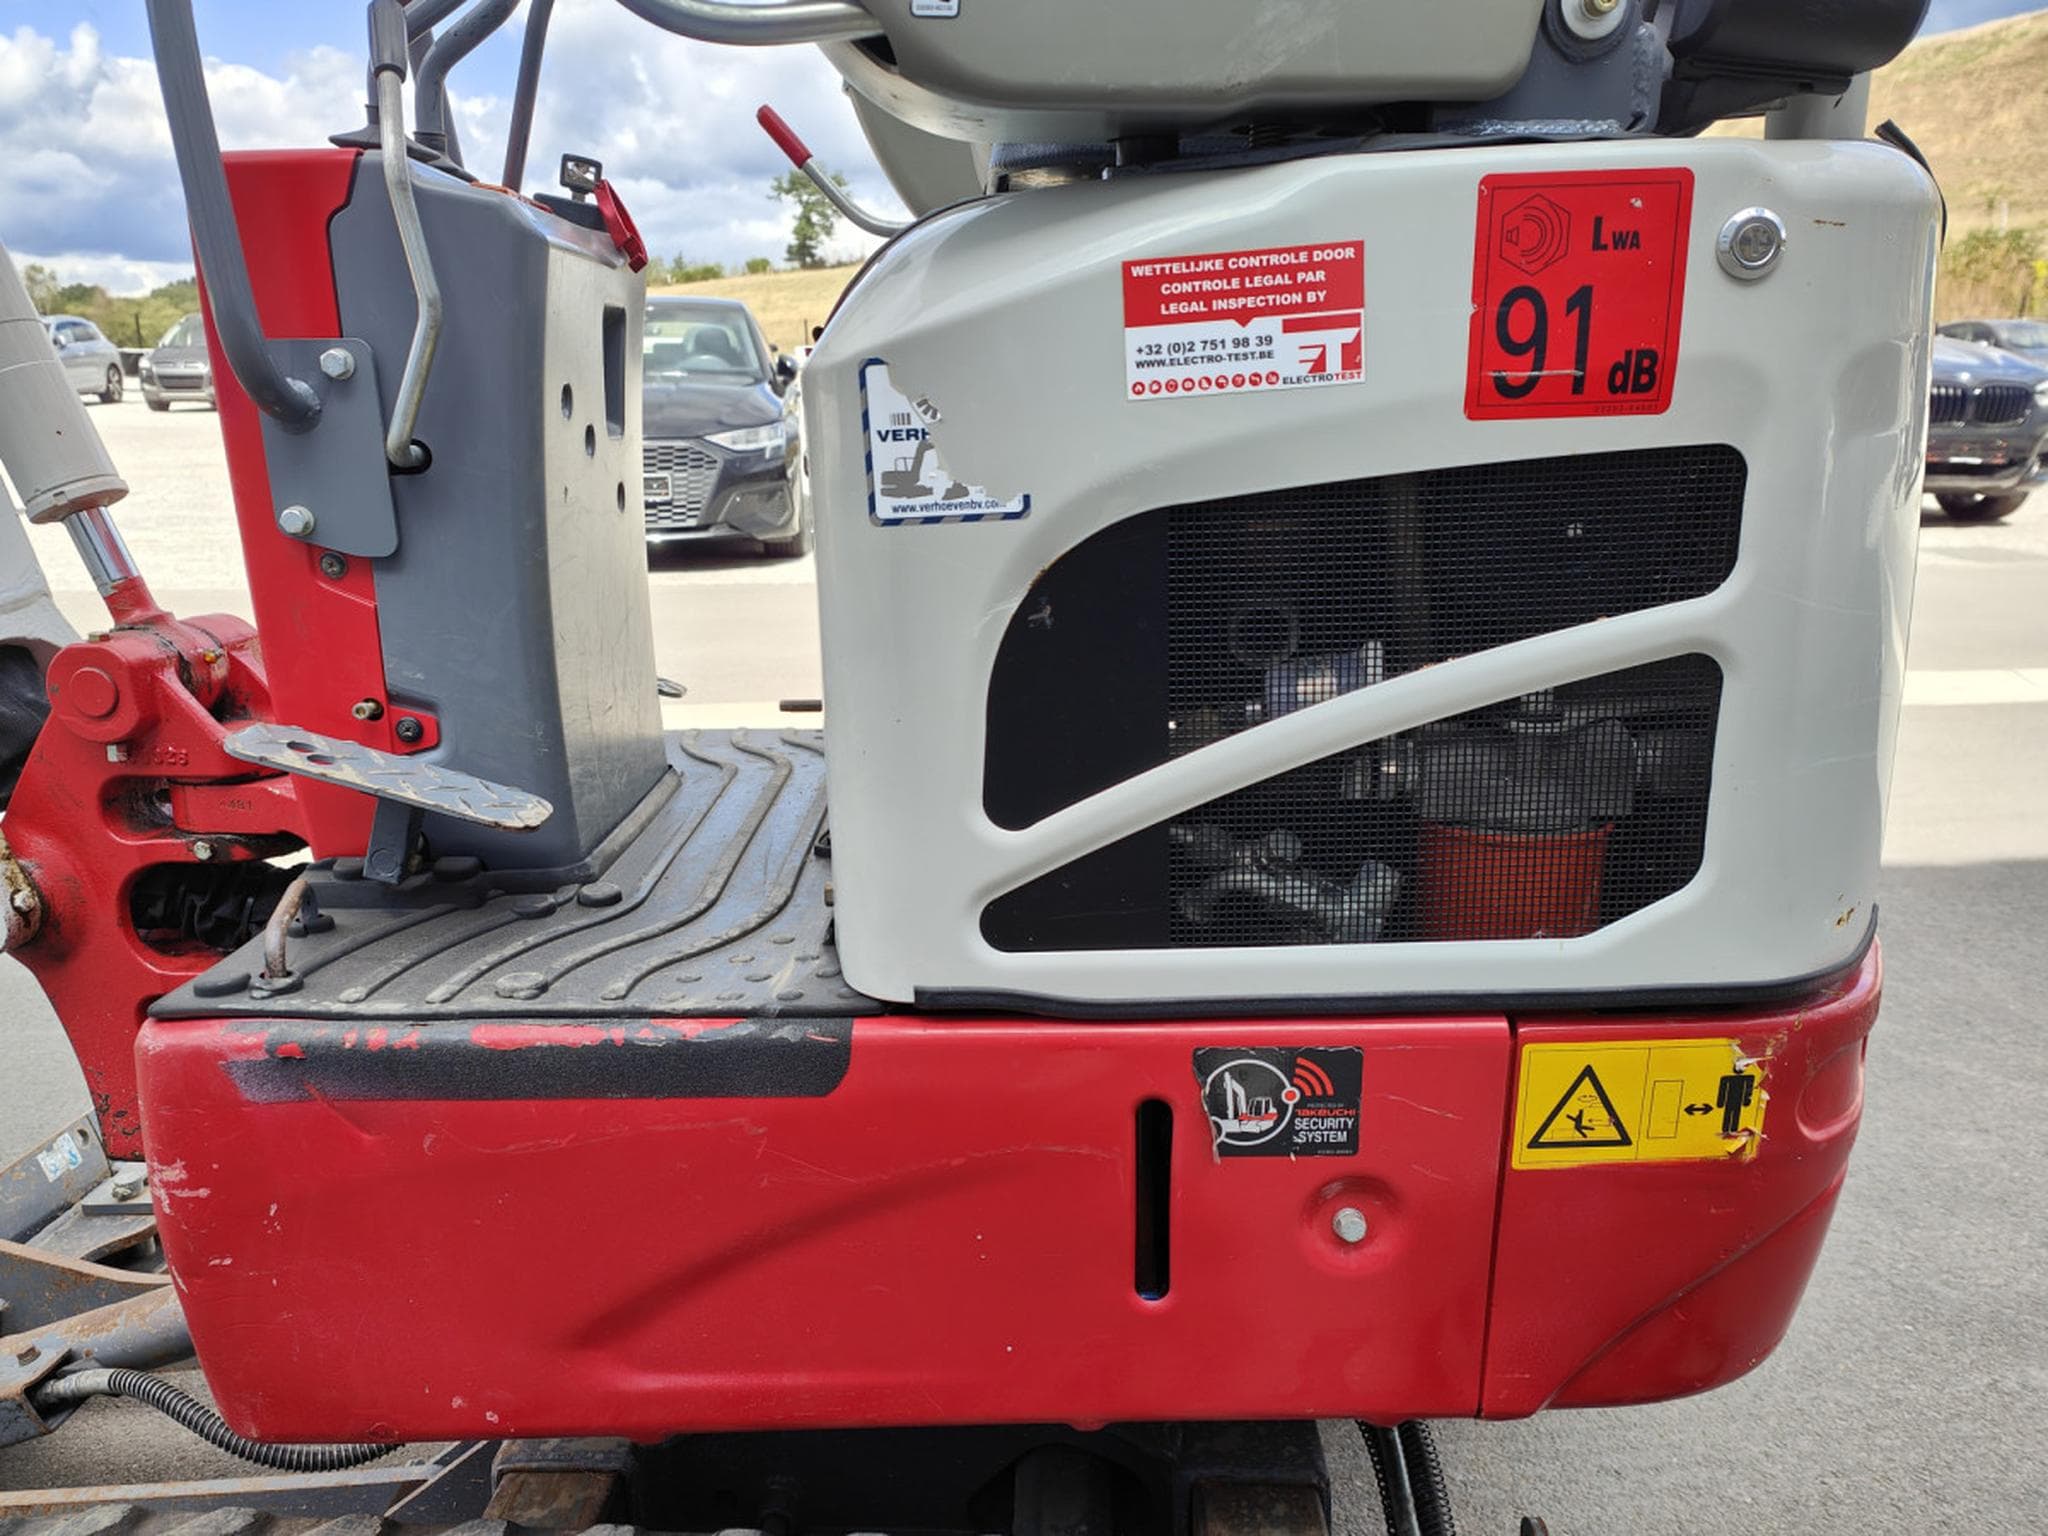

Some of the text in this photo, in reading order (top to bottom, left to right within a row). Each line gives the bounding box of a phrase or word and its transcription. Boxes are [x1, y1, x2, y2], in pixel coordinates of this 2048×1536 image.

[1130, 247, 1356, 278] WETTELIJKE CONTROLE DOOR
[1160, 270, 1327, 296] CONTROLE LEGAL PAR
[1160, 290, 1328, 316] LEGAL INSPECTION BY
[1135, 334, 1274, 356] +32 (0)2 751 98 39
[1492, 284, 1660, 400] 91 dB
[1135, 350, 1275, 370] WWW.ELECTRO-TEST.BE
[1282, 370, 1363, 386] ELECTROTEST
[1294, 1117, 1355, 1130] SECURITY
[1298, 1130, 1348, 1143] SYSTEM
